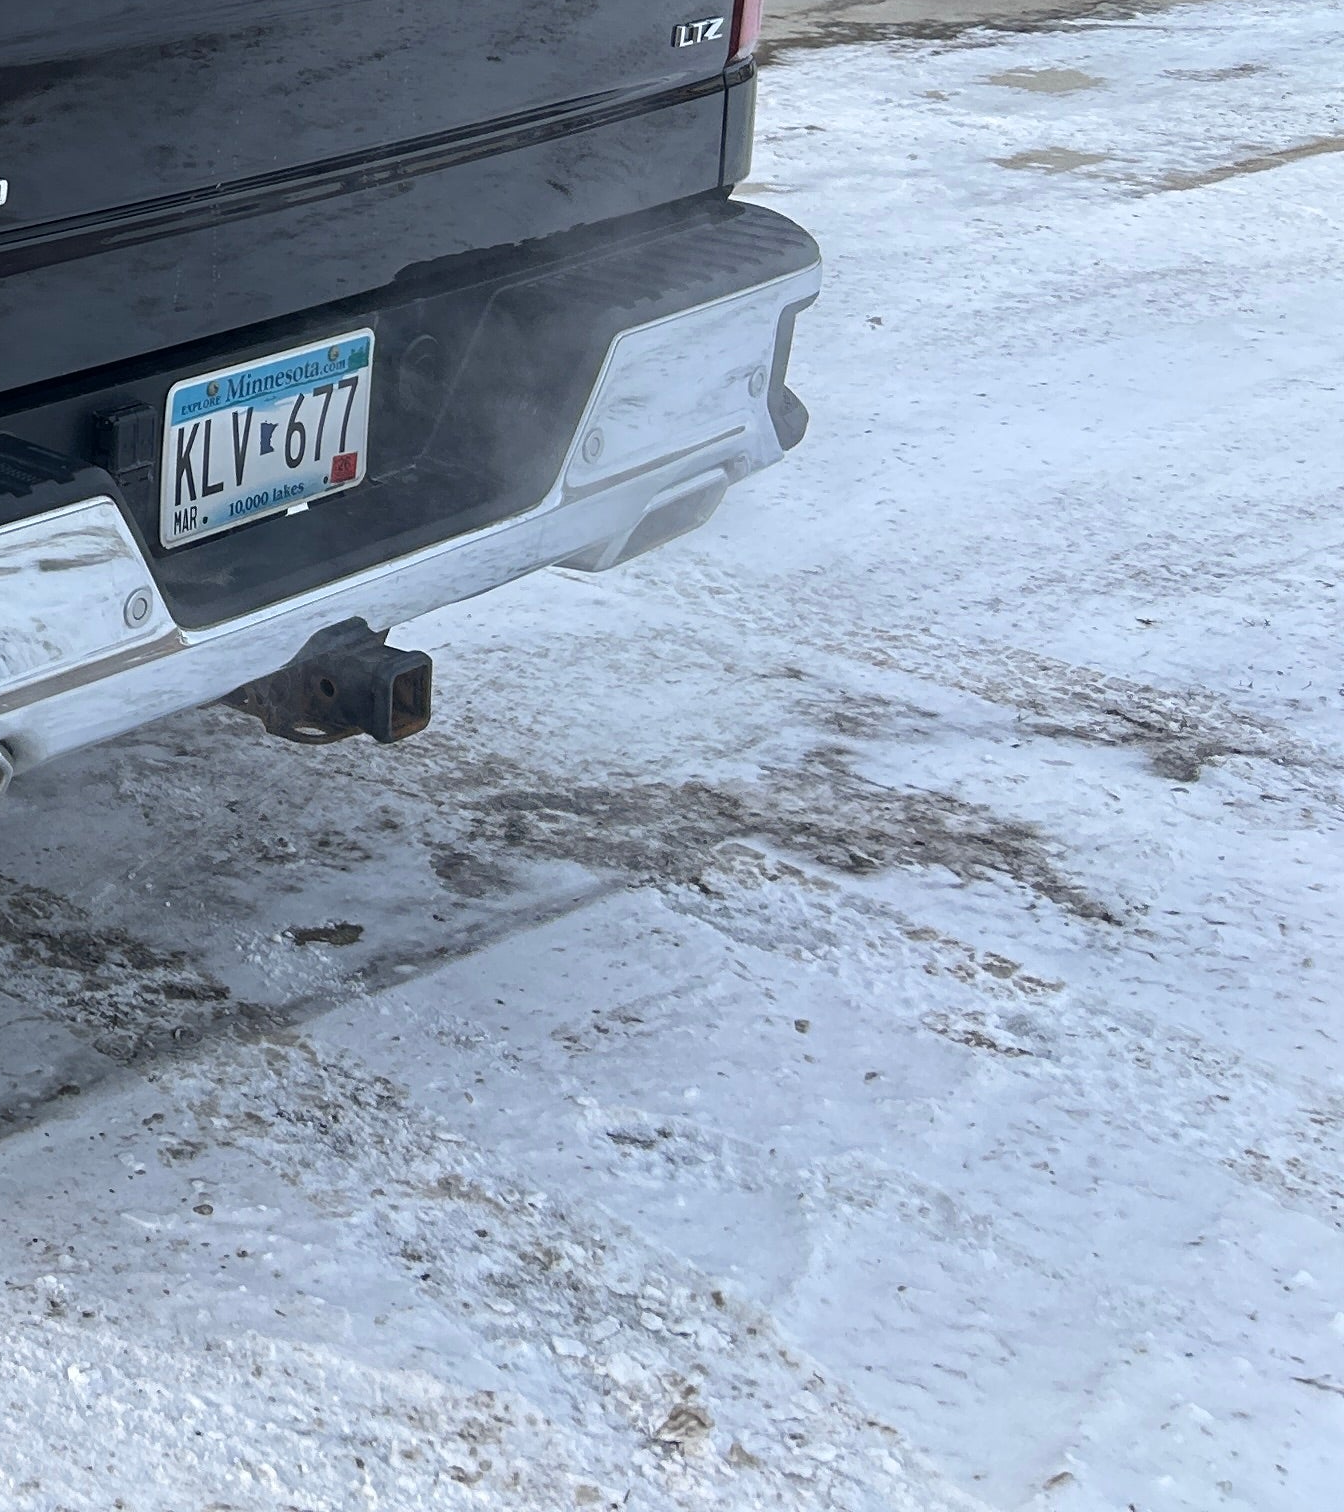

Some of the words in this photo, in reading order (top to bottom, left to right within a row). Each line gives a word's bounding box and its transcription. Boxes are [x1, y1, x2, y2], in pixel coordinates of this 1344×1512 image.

[671, 16, 725, 48] LTZ
[180, 396, 222, 417] EXPLORE
[174, 406, 254, 507] KLV
[284, 375, 359, 469] 677
[228, 491, 269, 517] 10,000
[272, 482, 305, 502] lakes
[173, 505, 199, 536] MAR
